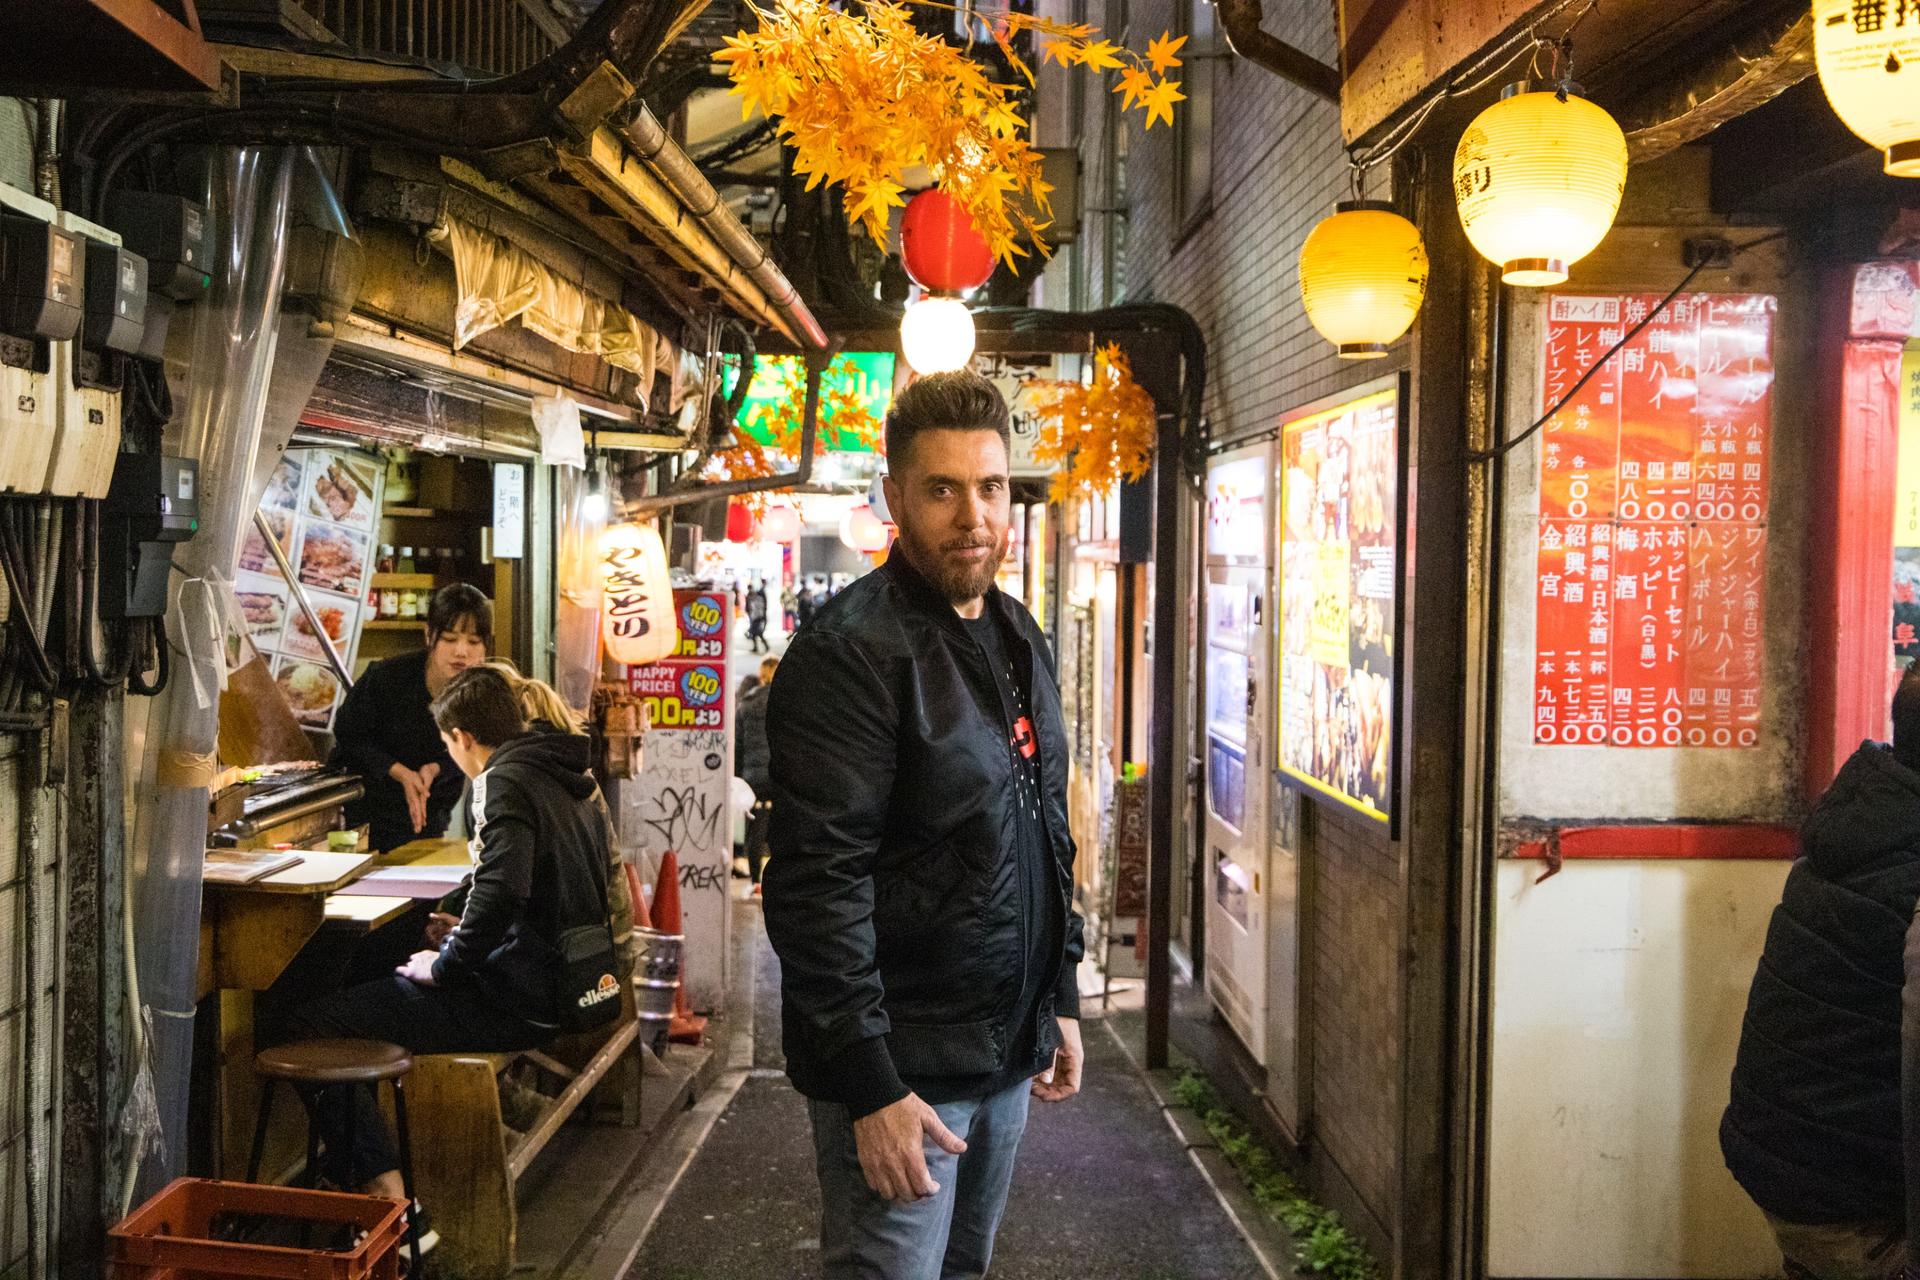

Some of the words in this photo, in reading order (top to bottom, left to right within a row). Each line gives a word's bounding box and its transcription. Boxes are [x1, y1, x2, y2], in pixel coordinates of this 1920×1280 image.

[1540, 524, 1562, 597] 金宮
[1563, 524, 1587, 603] 紹興酒
[1615, 526, 1639, 599] 梅酒
[689, 602, 719, 627] 100
[690, 619, 709, 633] YEN
[632, 667, 676, 681] HAPPY
[688, 671, 719, 695] 100
[632, 680, 676, 694] PRICE!
[689, 688, 709, 703] YEN
